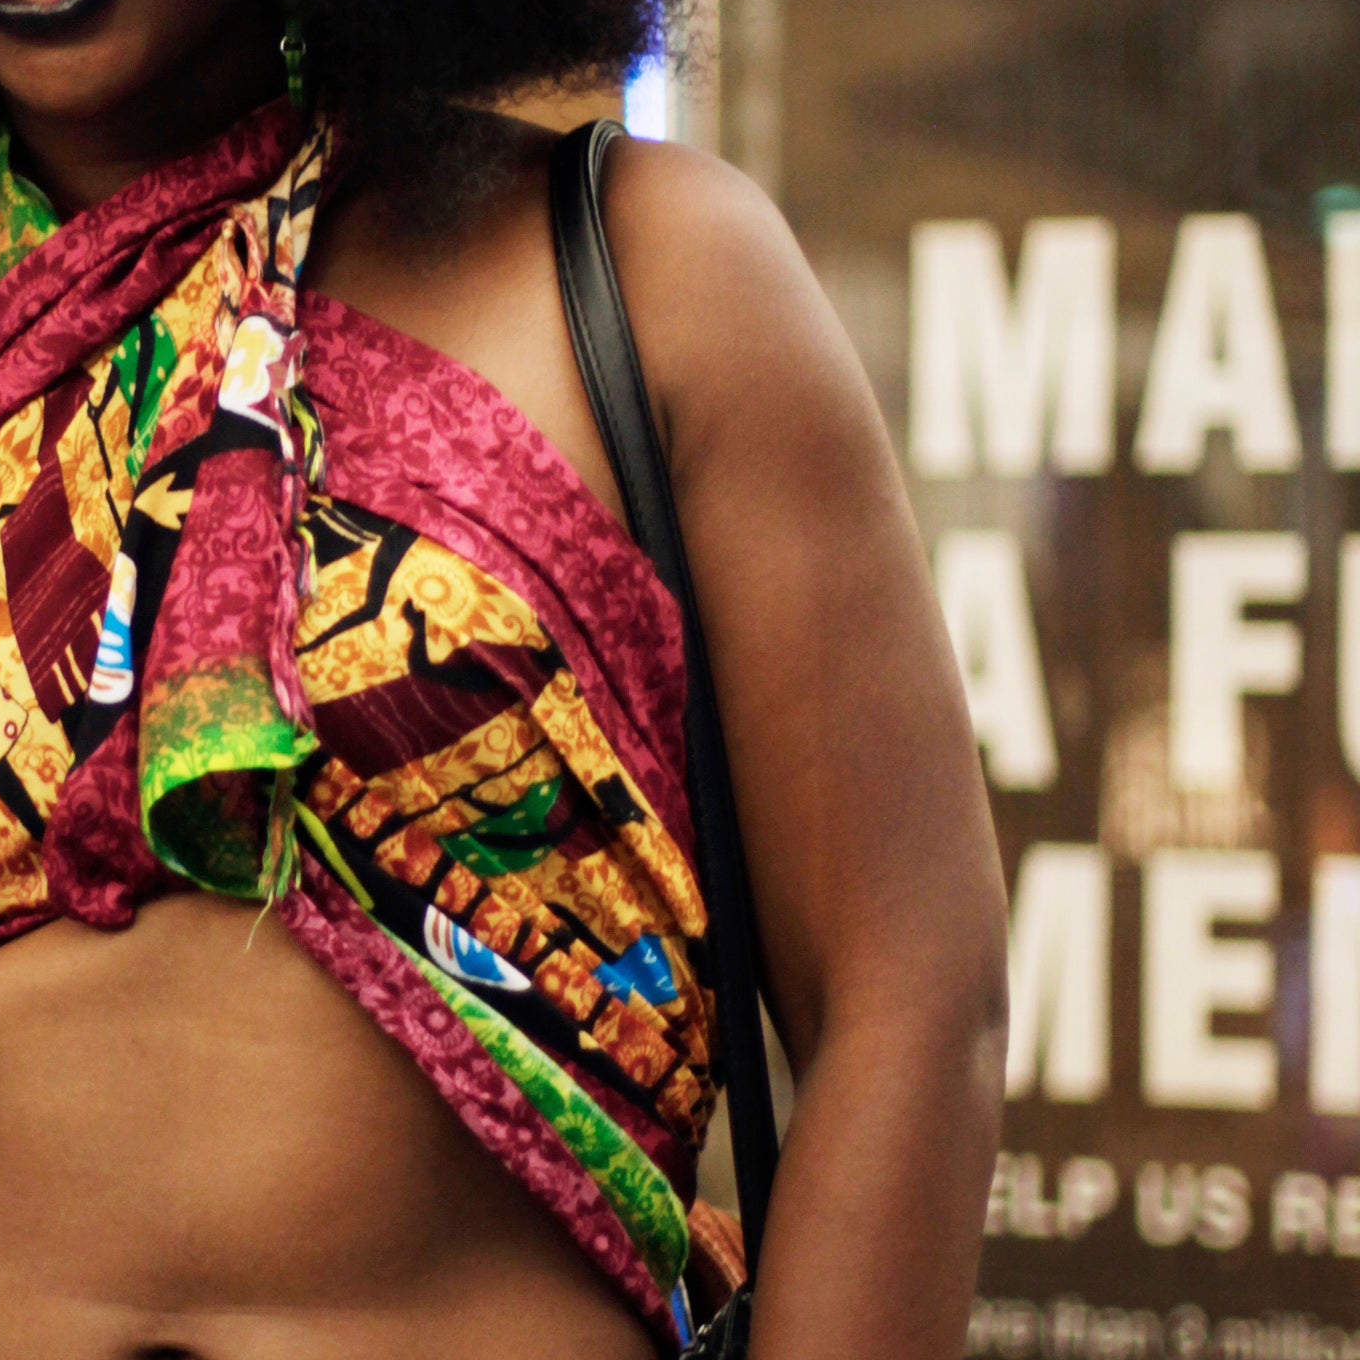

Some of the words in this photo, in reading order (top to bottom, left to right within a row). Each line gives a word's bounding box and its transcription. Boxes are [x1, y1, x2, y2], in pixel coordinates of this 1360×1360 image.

[908, 211, 1360, 477] MA
[934, 529, 1060, 792] A
[1005, 840, 1360, 1115] ME
[1135, 1161, 1253, 1251] US
